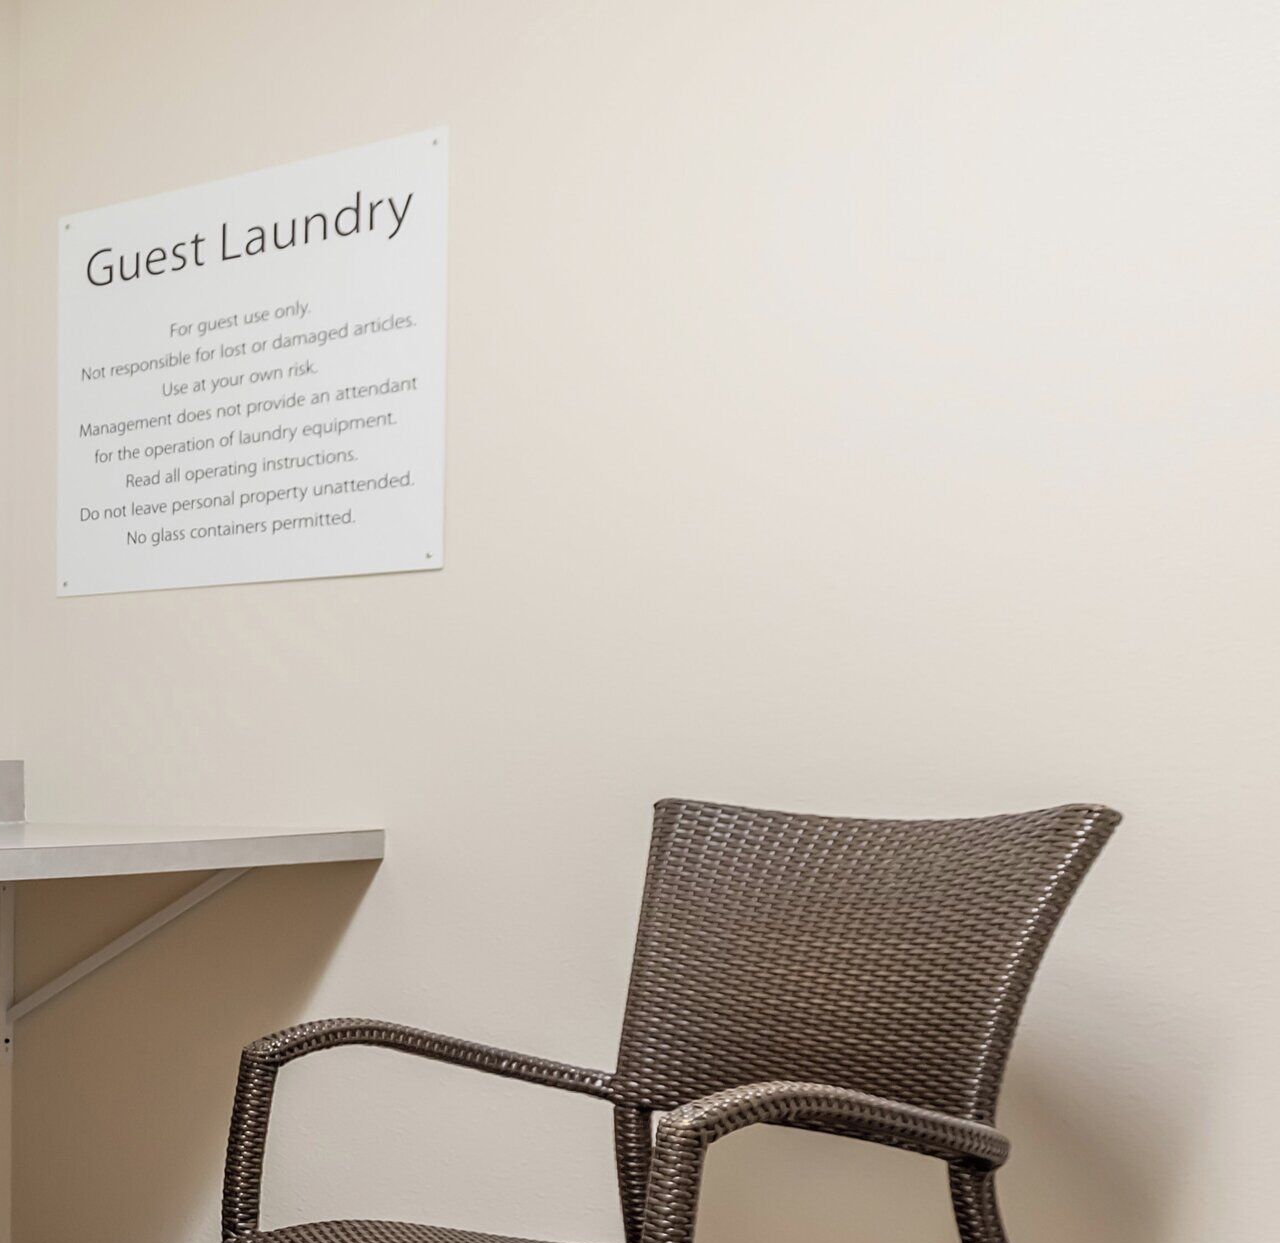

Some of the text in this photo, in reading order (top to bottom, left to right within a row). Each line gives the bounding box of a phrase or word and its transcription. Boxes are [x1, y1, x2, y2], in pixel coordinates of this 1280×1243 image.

[86, 190, 414, 287] Guest Laundry
[169, 300, 312, 338] For guest use only.
[81, 313, 418, 382] Not responsible for lost or damaged articles.
[162, 359, 319, 397] Use at your own risk.
[79, 376, 418, 437] Management does not provide an attendant
[95, 412, 397, 463] for the operation of laundry equipment.
[125, 449, 358, 488] Read all operating instructions.
[79, 470, 415, 522] Do not leave personal property unattended.
[127, 508, 356, 547] No glass containers permitted.
